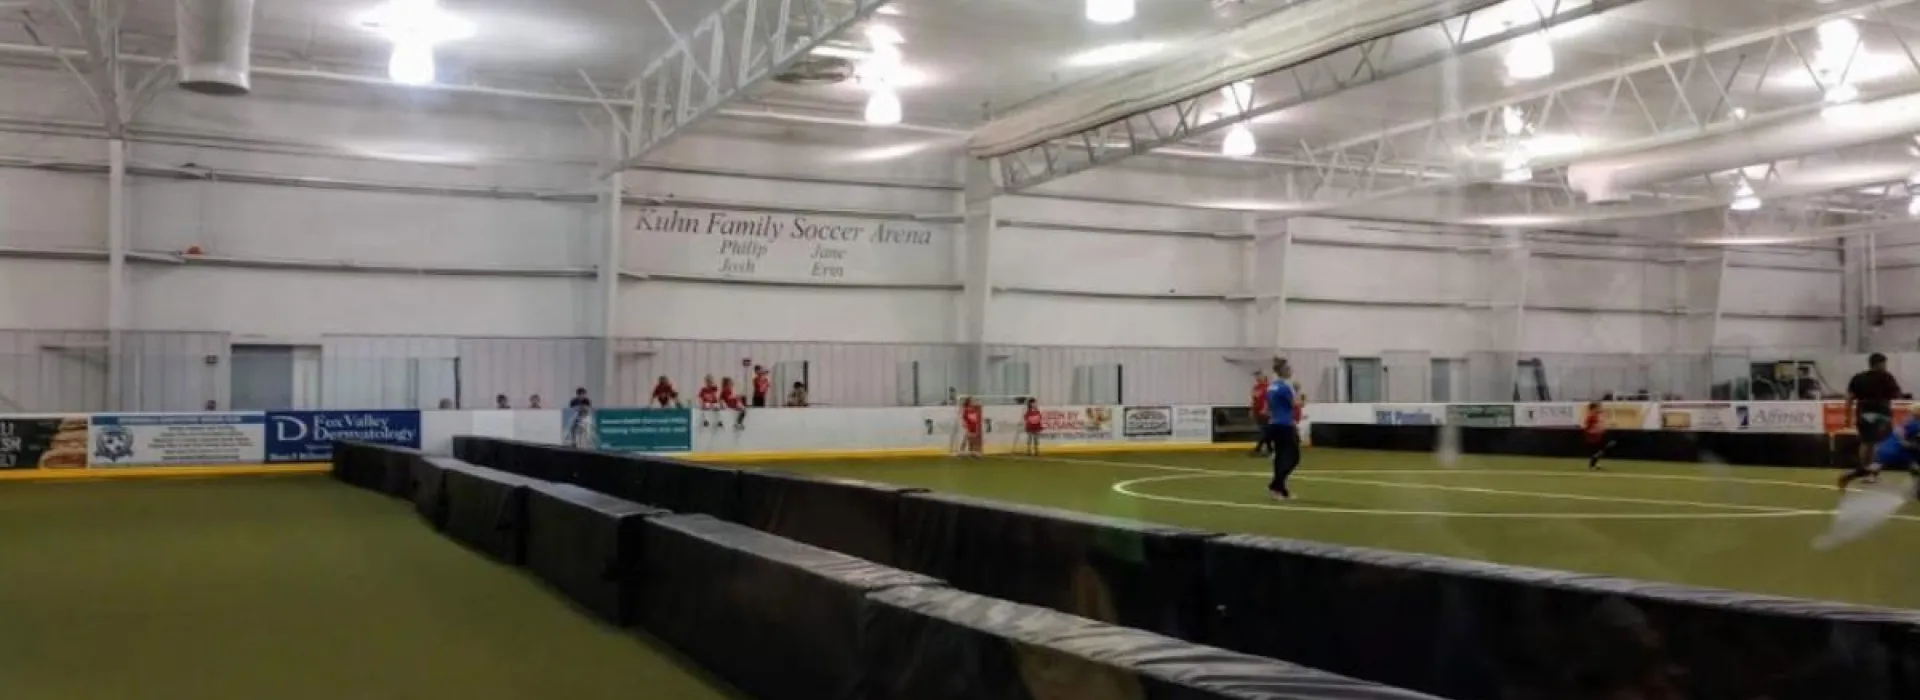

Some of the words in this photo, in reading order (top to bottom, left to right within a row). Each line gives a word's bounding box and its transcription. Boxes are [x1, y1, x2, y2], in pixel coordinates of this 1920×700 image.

[634, 208, 699, 234] Kuhn
[706, 212, 784, 243] Family
[790, 216, 864, 241] Soccer
[868, 222, 932, 246] Arena
[719, 239, 768, 258] Philip
[810, 243, 847, 261] Jane
[313, 414, 343, 428] Fox
[343, 414, 389, 428] Valley
[314, 426, 417, 441] Dermatology
